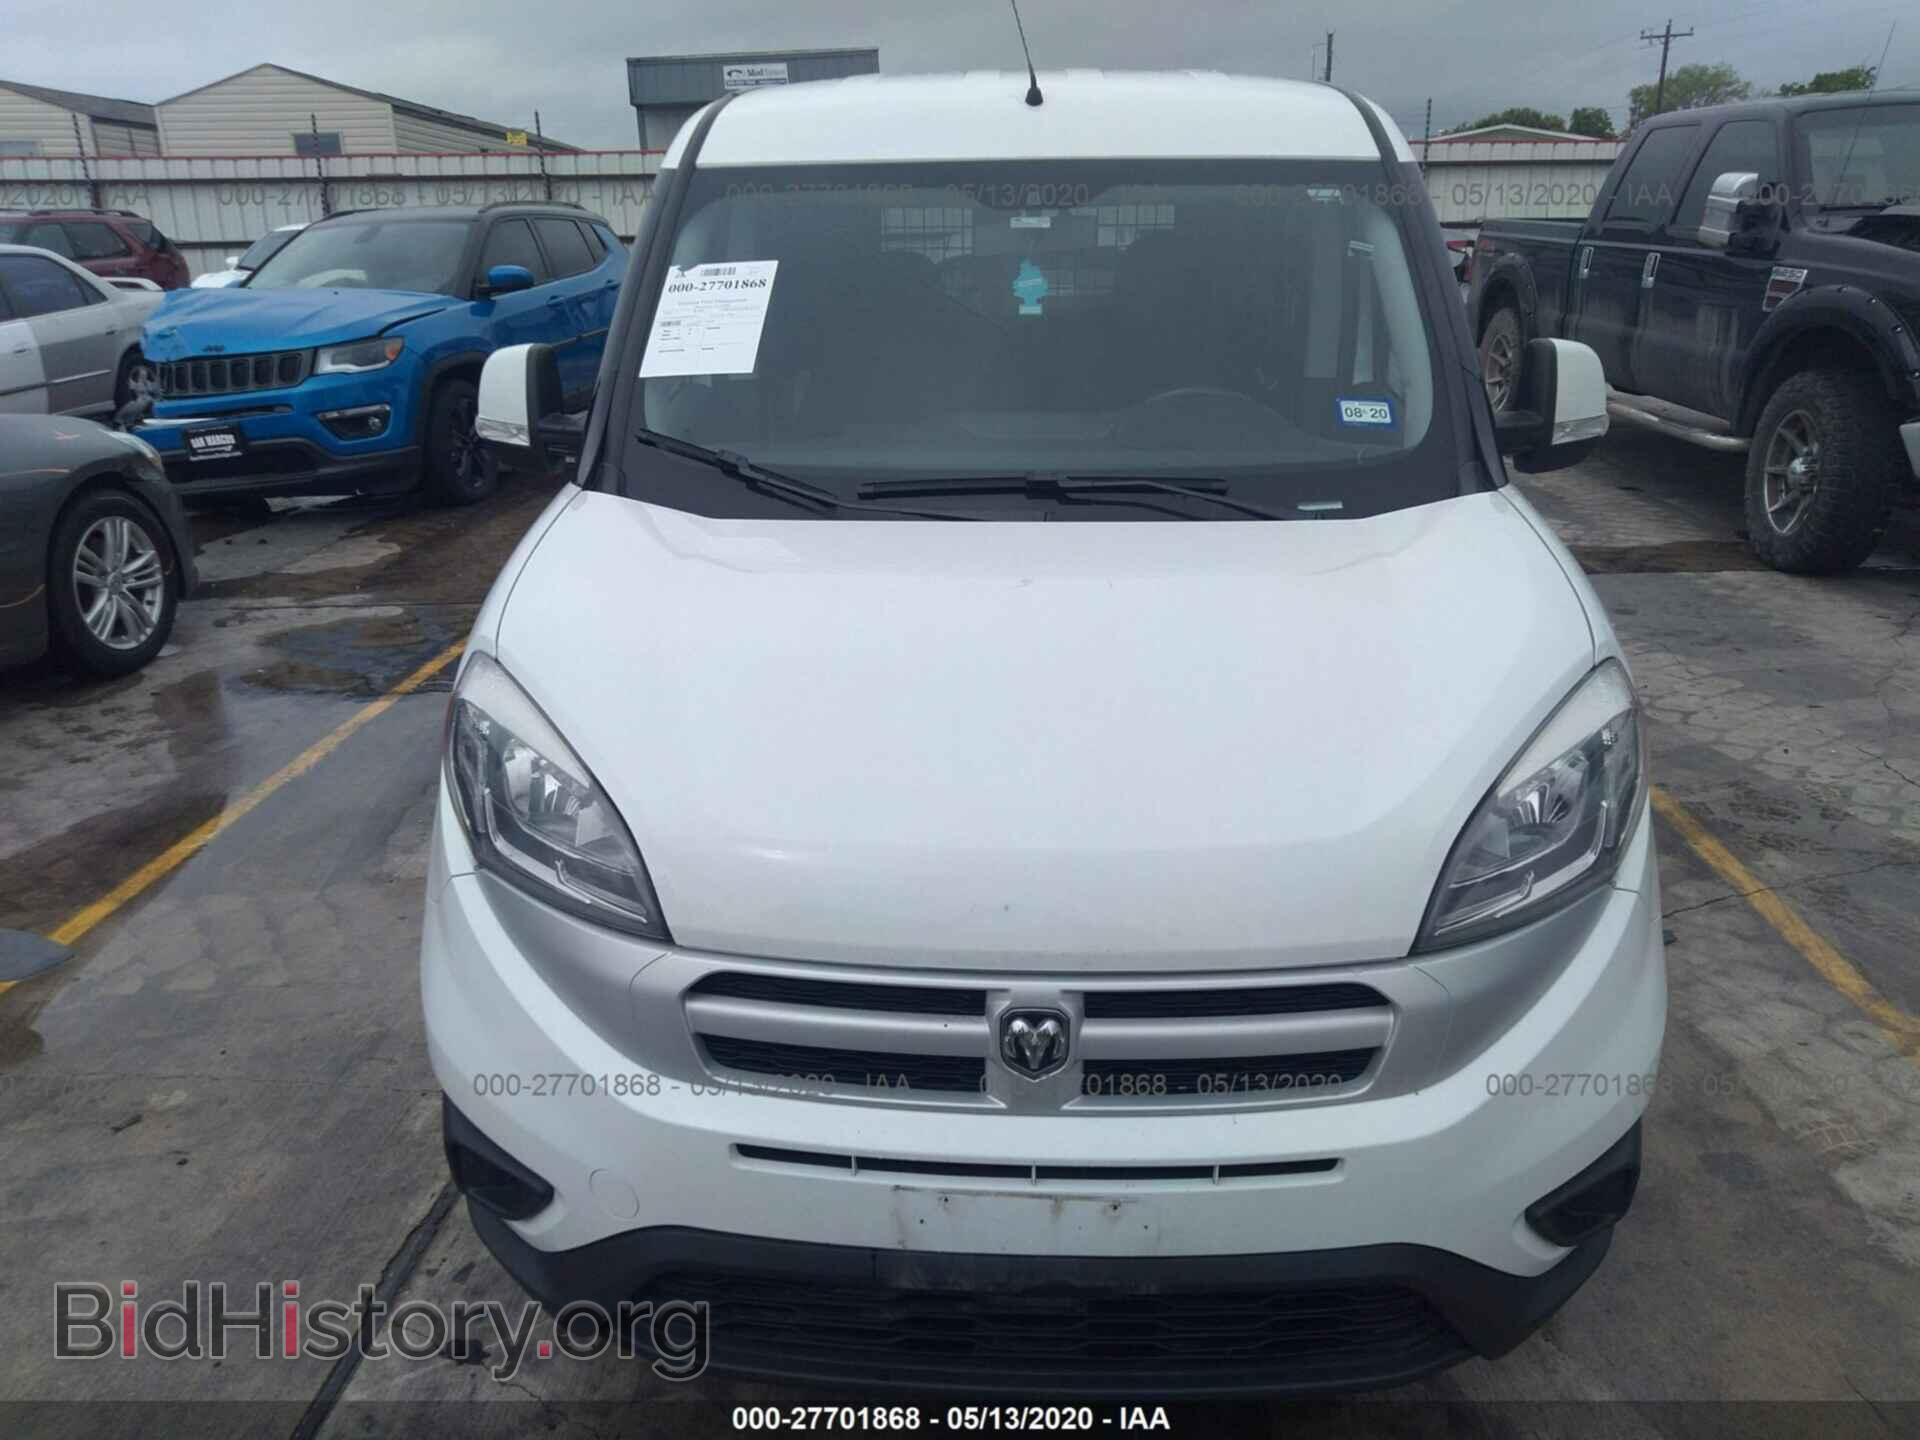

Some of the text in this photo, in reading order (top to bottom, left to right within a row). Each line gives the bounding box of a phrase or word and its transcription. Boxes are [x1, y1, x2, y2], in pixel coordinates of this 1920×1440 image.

[668, 279, 767, 293] 000-27701868
[1344, 407, 1388, 419] 08 20
